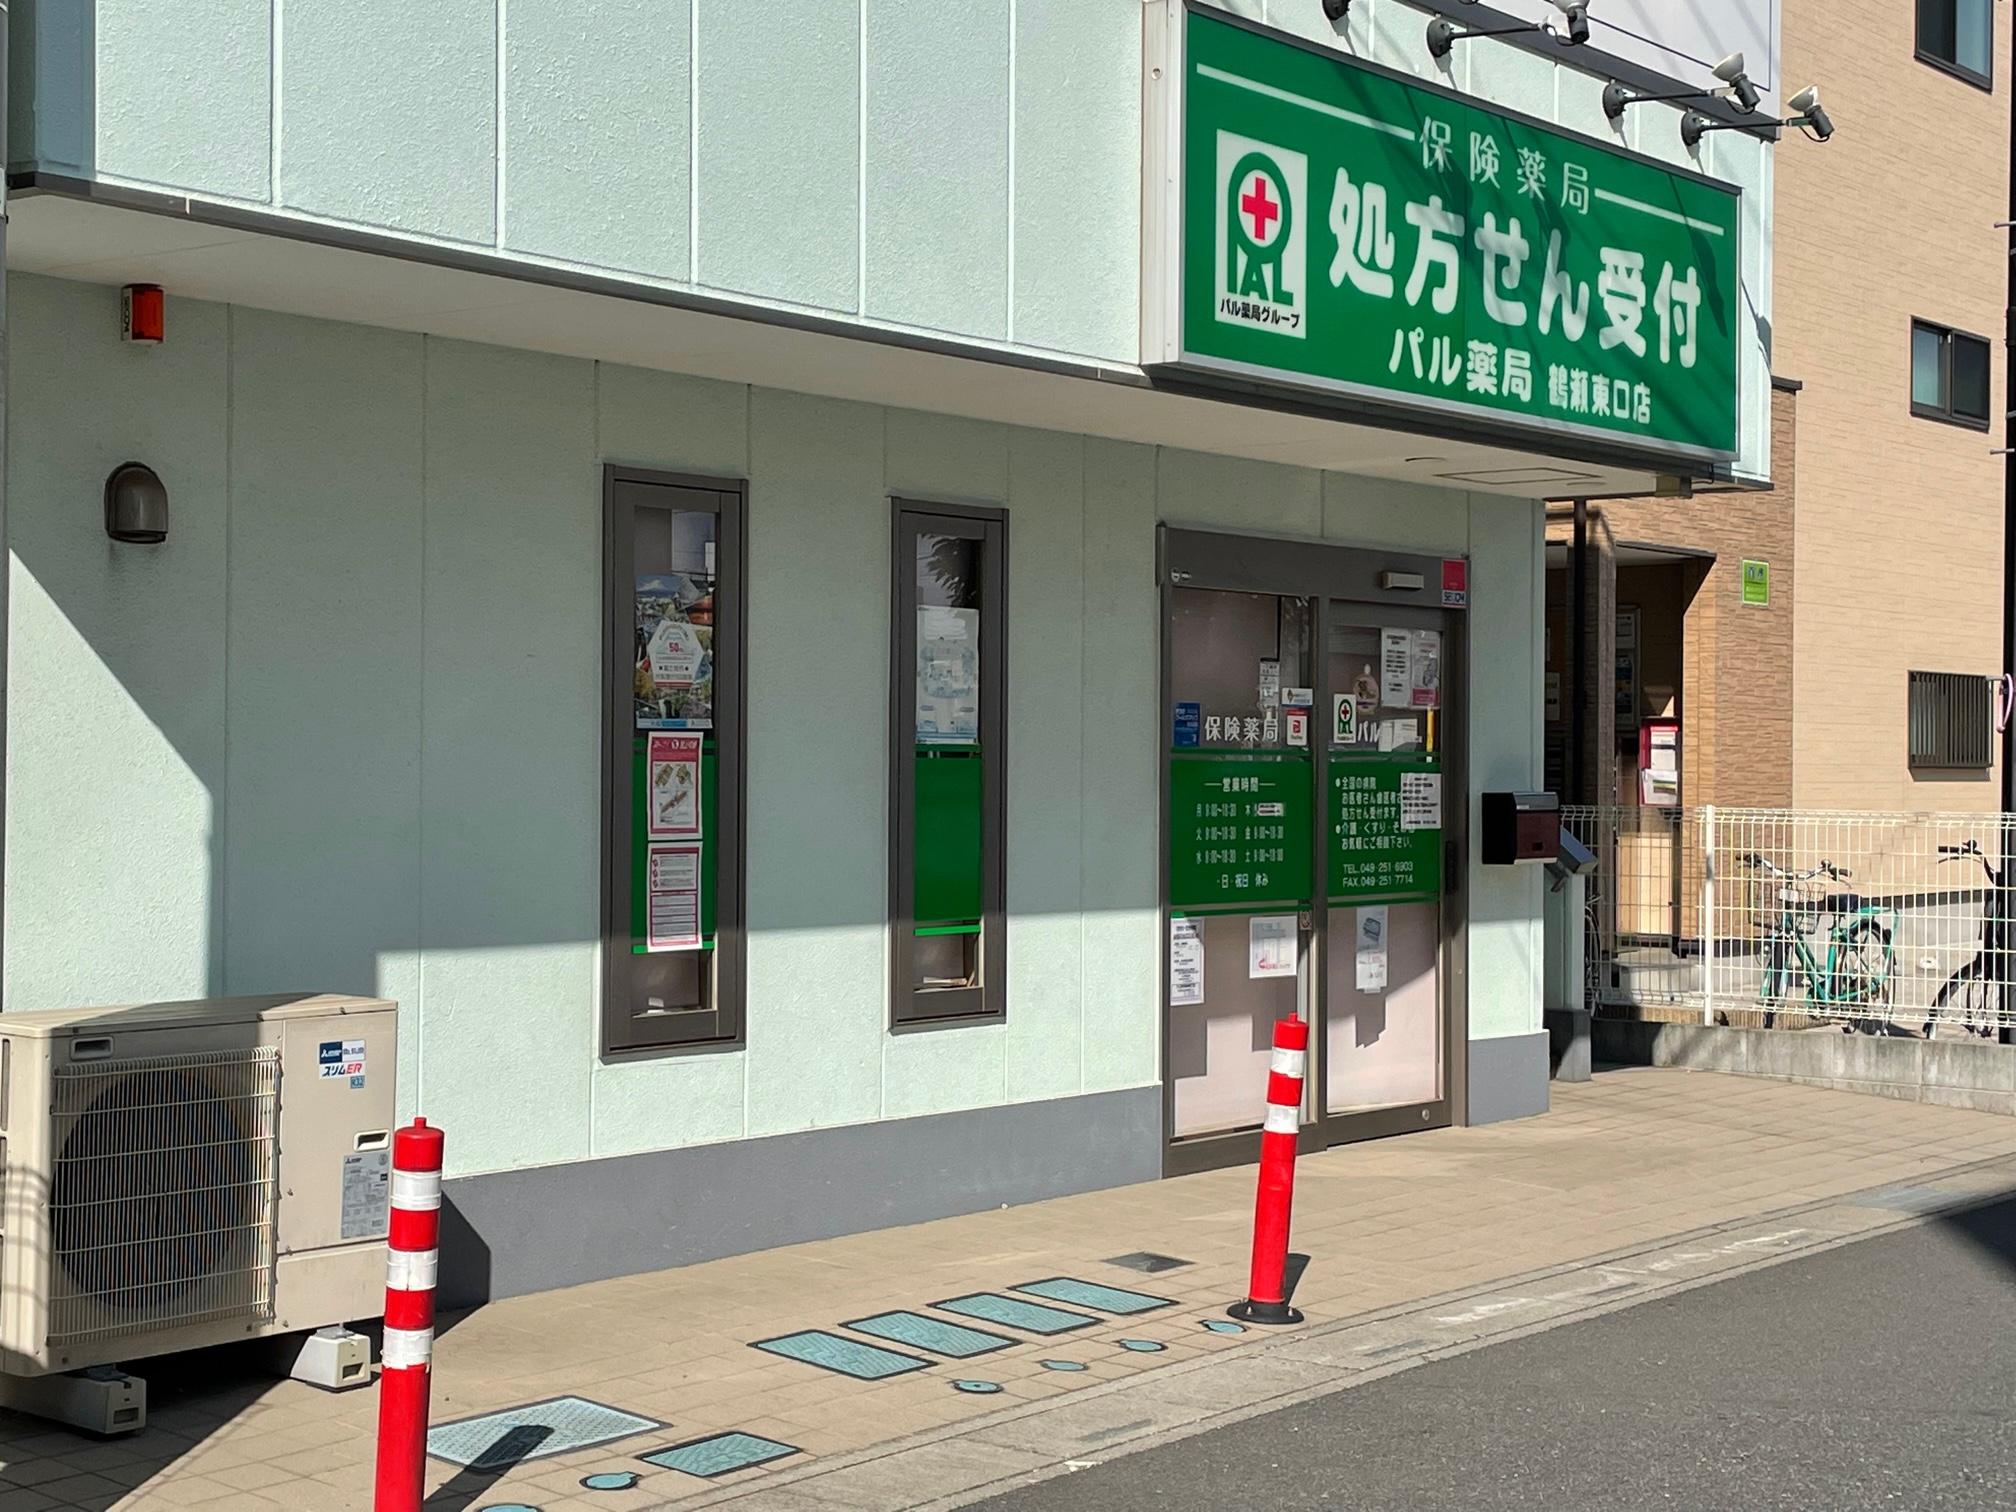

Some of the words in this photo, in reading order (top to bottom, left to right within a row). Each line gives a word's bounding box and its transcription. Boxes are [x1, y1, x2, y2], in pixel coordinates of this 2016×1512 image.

[1420, 115, 1589, 216] 保険薬局
[1329, 166, 1701, 368] 処方せん受付
[1220, 297, 1301, 329] パル薬局グループ
[1389, 326, 1533, 402] パル薬局
[1549, 362, 1652, 424] 鶴瀬東口店
[1204, 715, 1279, 743] 保険薬局
